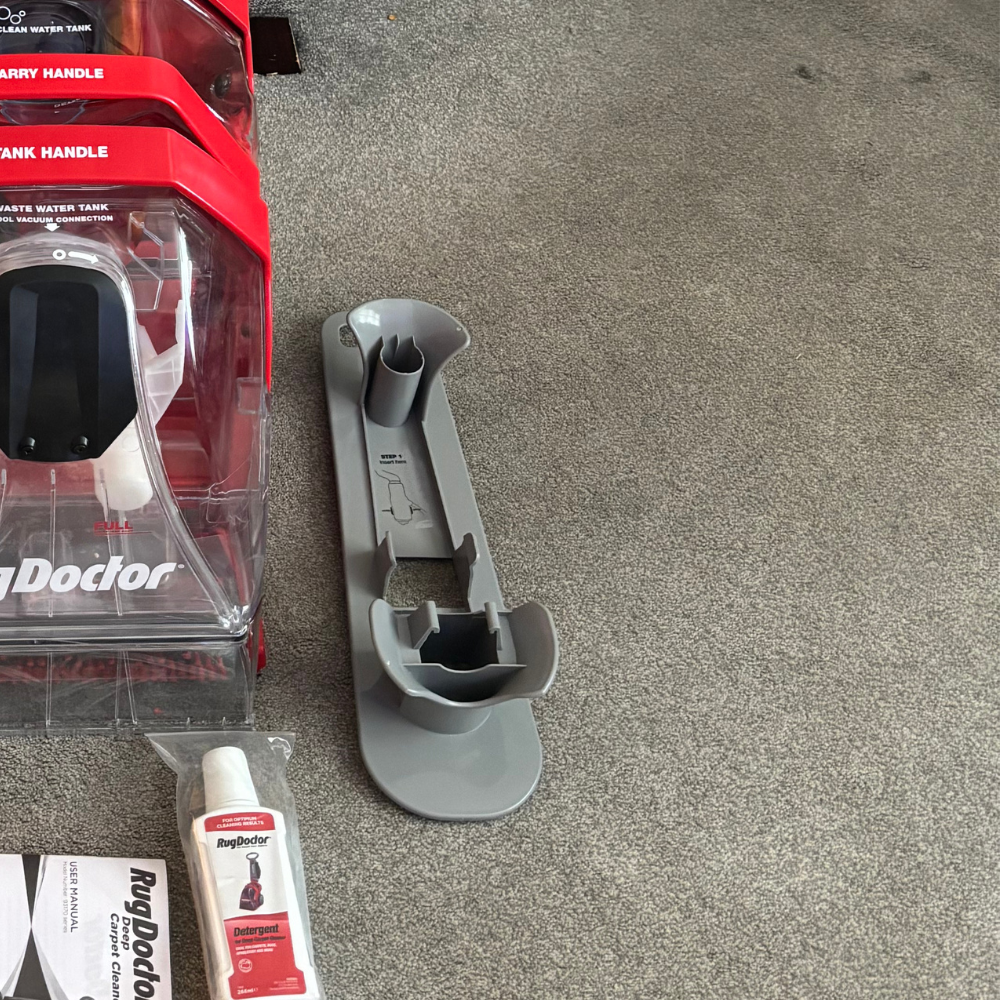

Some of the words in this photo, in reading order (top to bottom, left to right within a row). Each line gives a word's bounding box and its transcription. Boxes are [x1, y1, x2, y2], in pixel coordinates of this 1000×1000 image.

[66, 24, 92, 32] TANK
[43, 68, 104, 79] HANDLE
[42, 146, 108, 158] HANDLE
[93, 521, 133, 530] FULL
[217, 835, 269, 849] RugDoctor
[70, 862, 78, 884] USER
[70, 888, 78, 932] MANUAL
[109, 913, 120, 958] Carpet
[121, 916, 131, 950] Deep
[234, 924, 279, 937] Detergent
